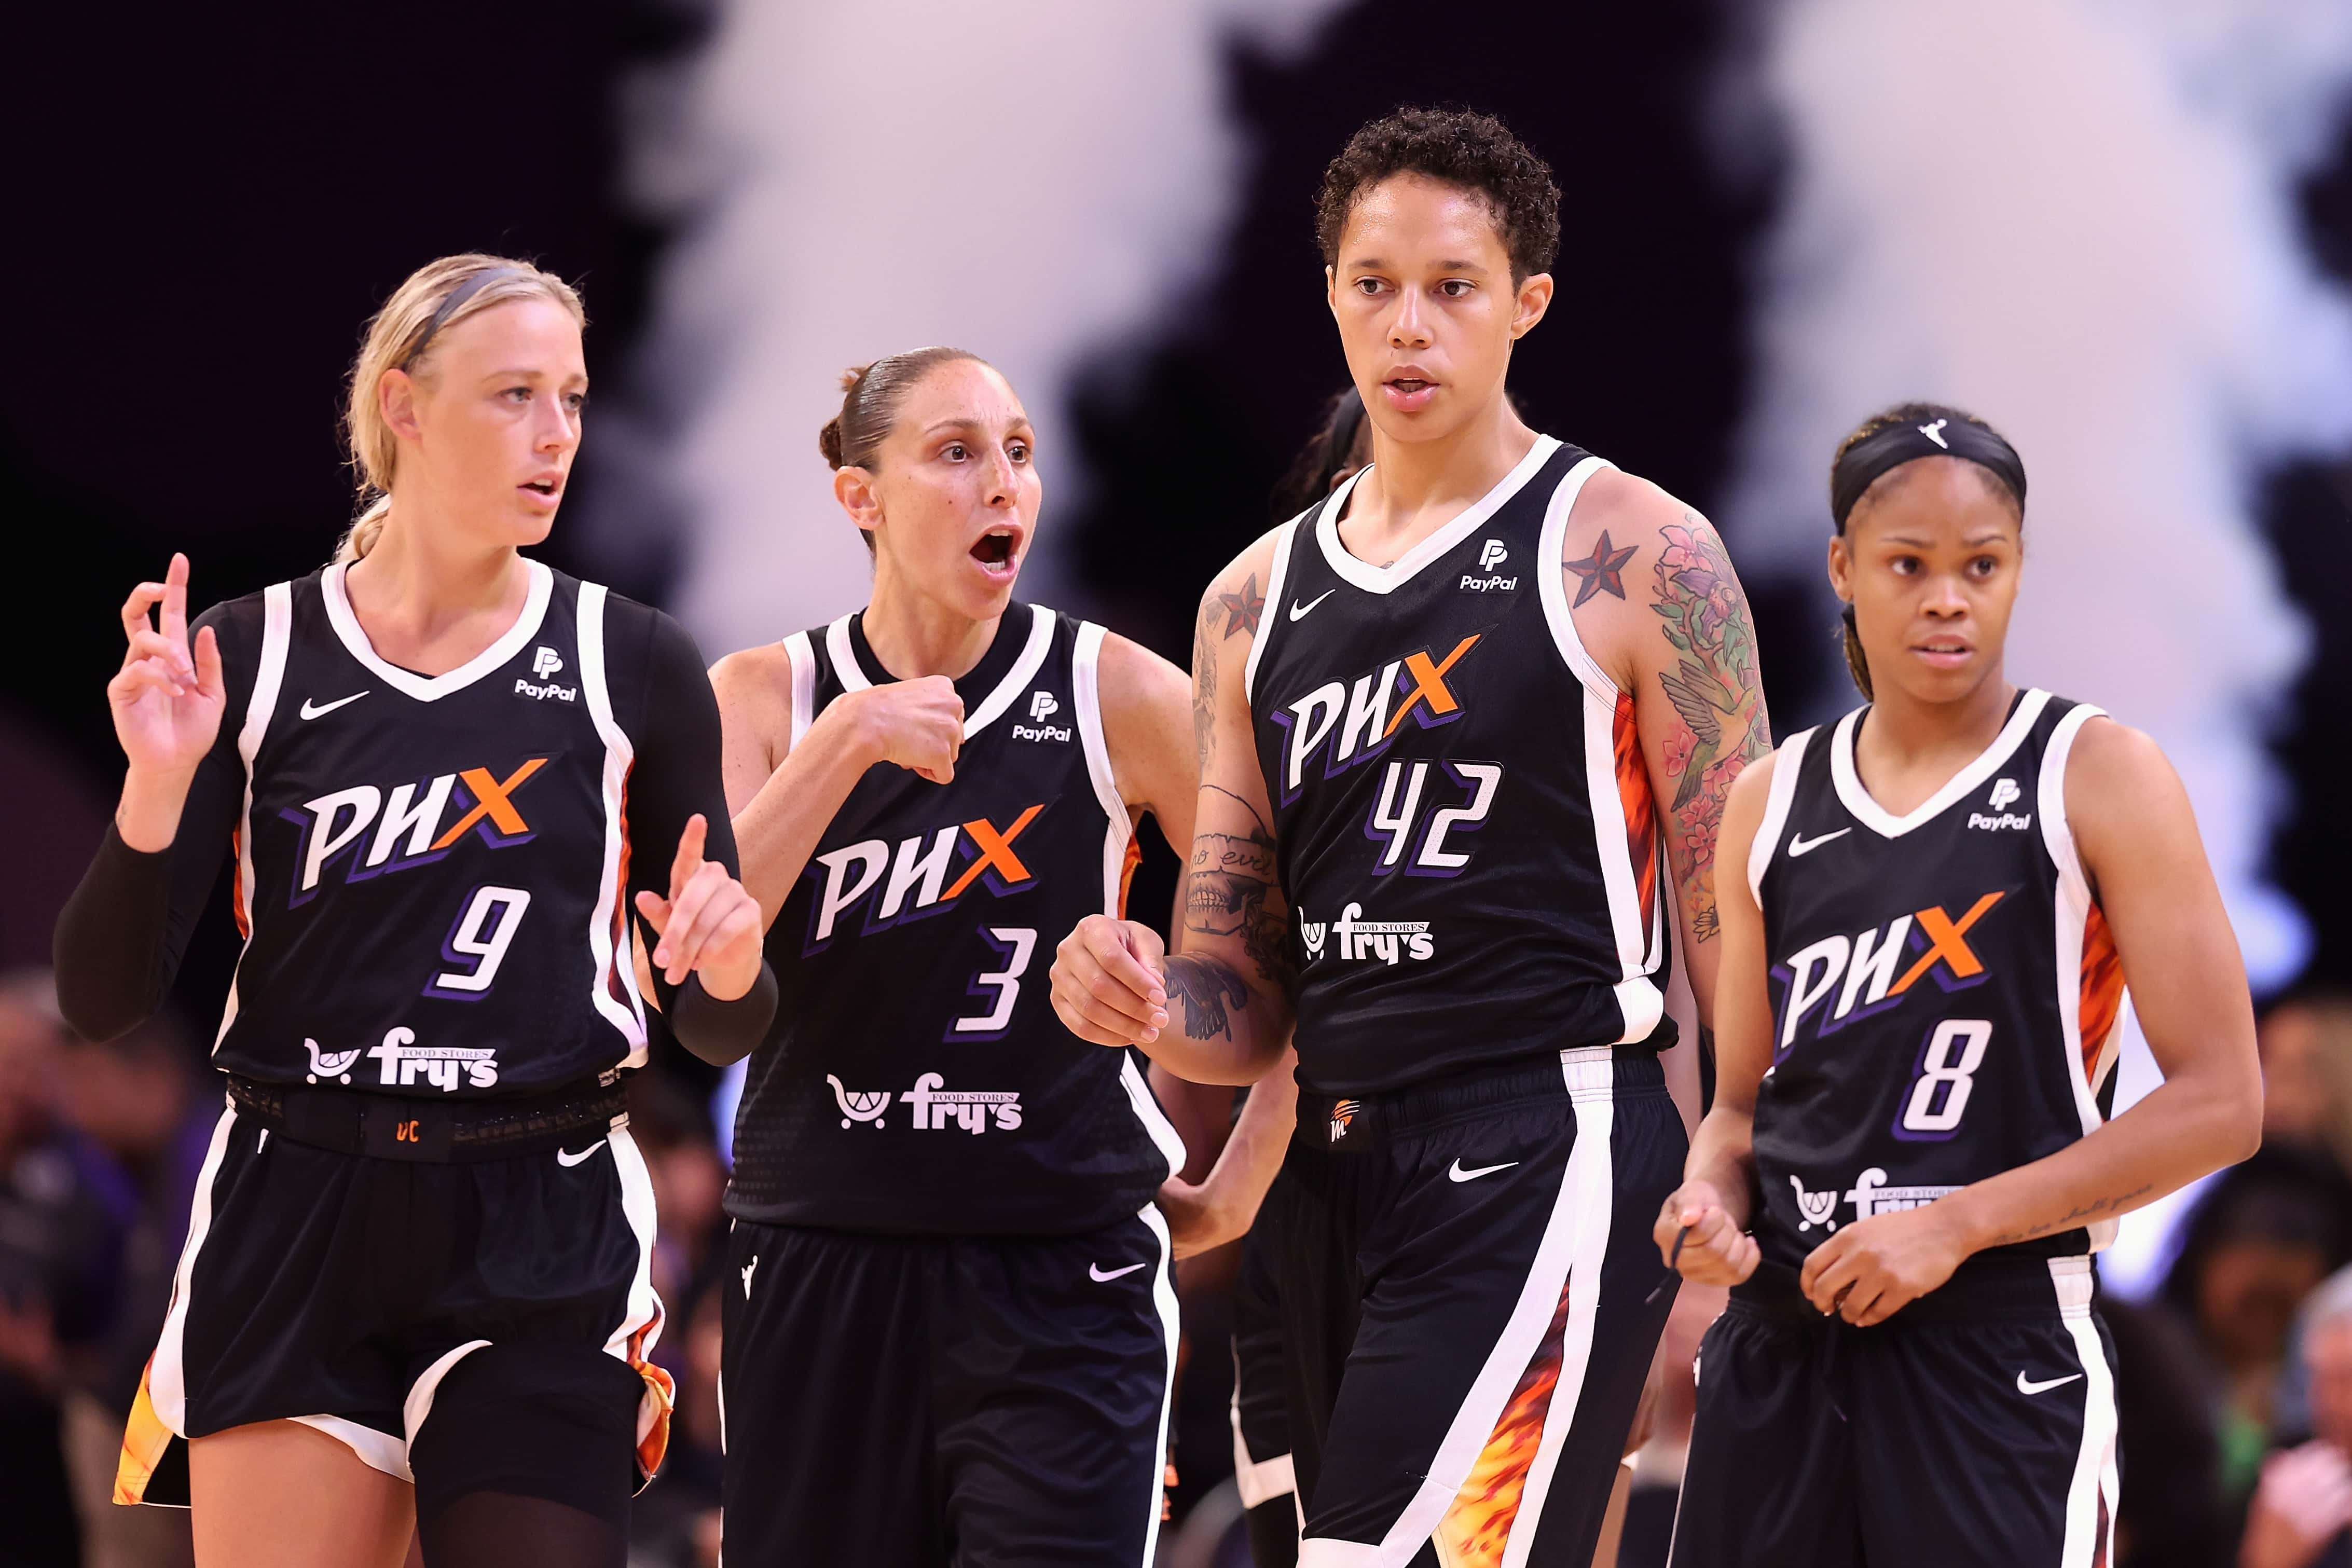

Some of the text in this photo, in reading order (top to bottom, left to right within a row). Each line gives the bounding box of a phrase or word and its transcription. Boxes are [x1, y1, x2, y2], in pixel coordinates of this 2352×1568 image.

[1460, 575, 1517, 592] PayPal
[514, 679, 576, 702] PayPal
[1288, 634, 1481, 790] PHX
[1012, 725, 1071, 742] PayPal
[302, 758, 548, 891] PHX
[1373, 758, 1502, 867] 42
[1968, 813, 2031, 831] PayPal
[815, 804, 1044, 941] PHX
[436, 886, 531, 991] 9
[1331, 902, 1434, 966] fry's
[1382, 924, 1425, 932] STORES
[955, 928, 1037, 1031] 3
[1781, 891, 2004, 1050] PHX
[366, 1027, 498, 1092] fry's
[402, 1049, 489, 1058] FOOD STORES
[1903, 1020, 1992, 1130] 8
[899, 1072, 1022, 1135] fry's
